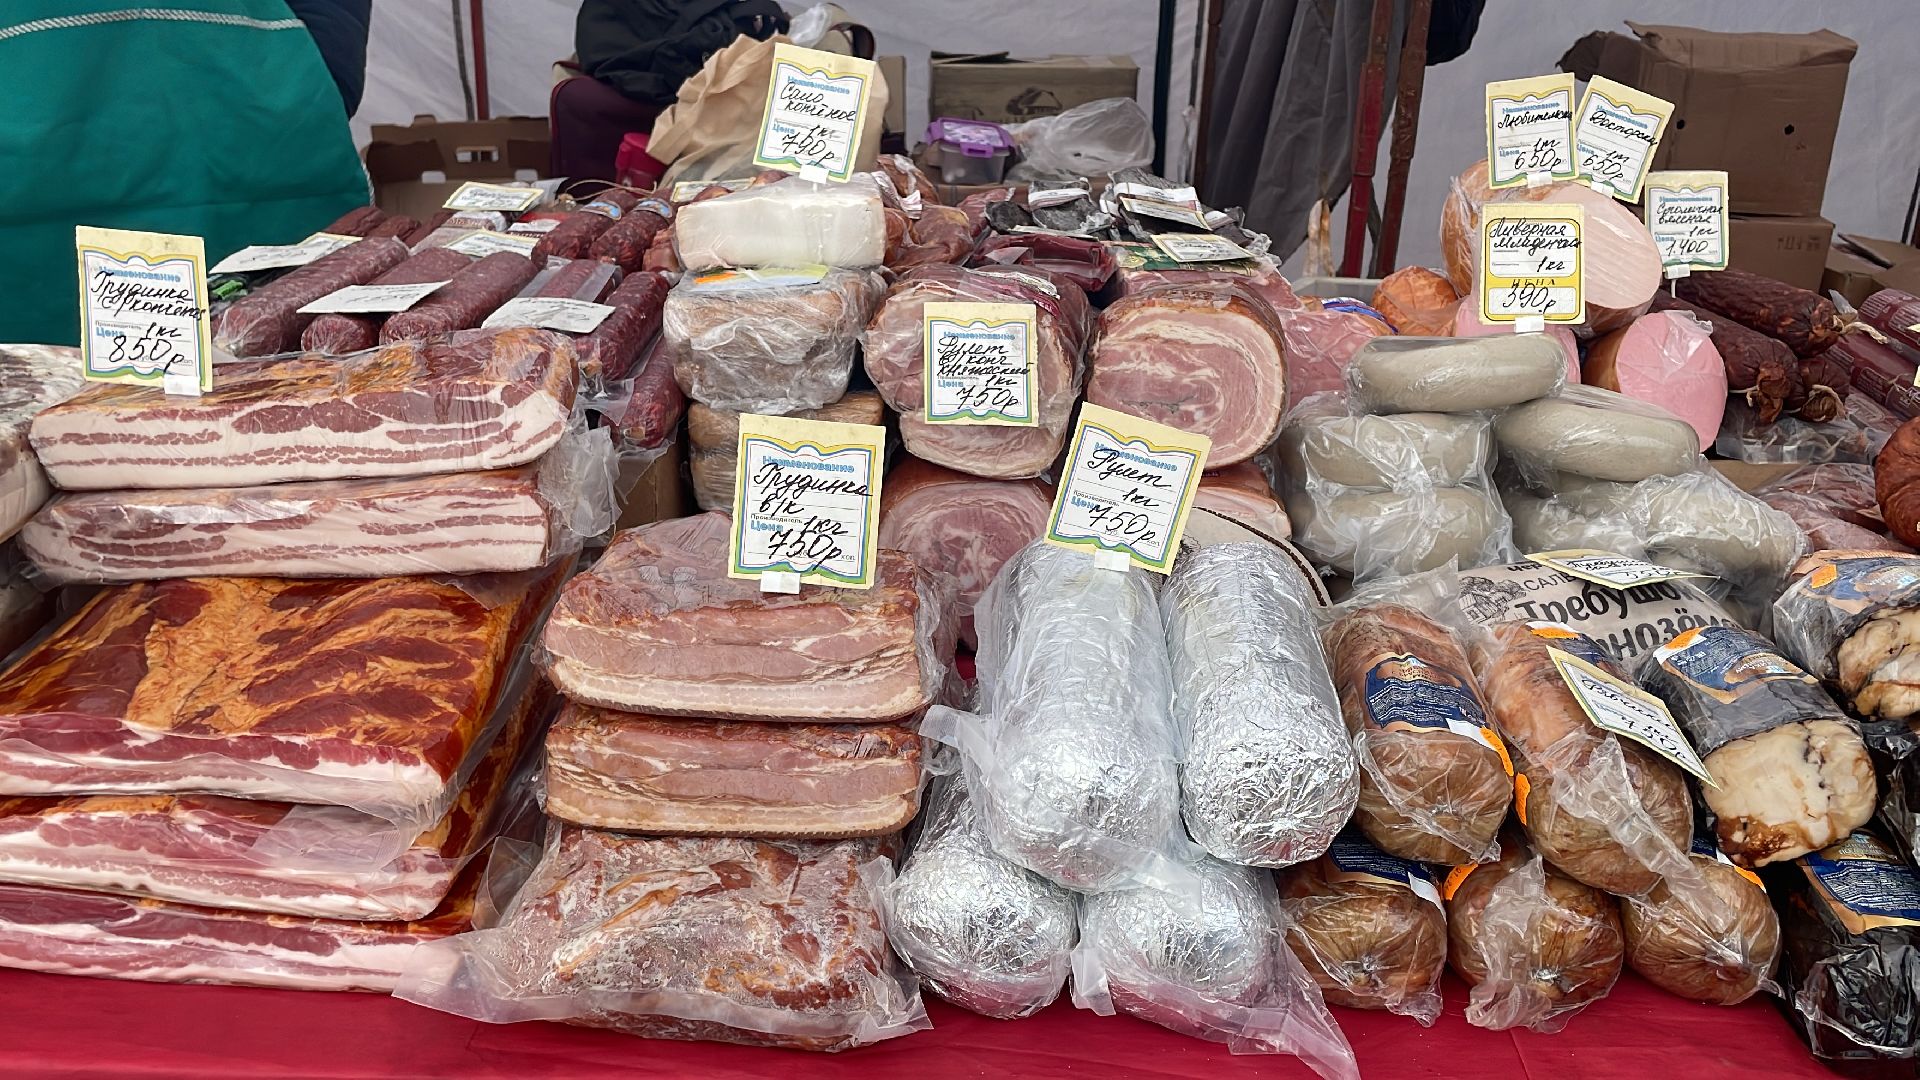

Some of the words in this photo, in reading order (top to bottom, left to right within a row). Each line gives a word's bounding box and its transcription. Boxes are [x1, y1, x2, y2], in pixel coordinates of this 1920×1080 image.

[781, 82, 824, 103] Сало
[1489, 217, 1567, 238] Ливерная
[91, 270, 193, 303] Грудинка
[938, 336, 1009, 354] Рулет
[1087, 449, 1172, 487] Рулет
[754, 462, 873, 499] Грудинка
[1070, 496, 1099, 510] Цен
[750, 520, 784, 532] Цена
